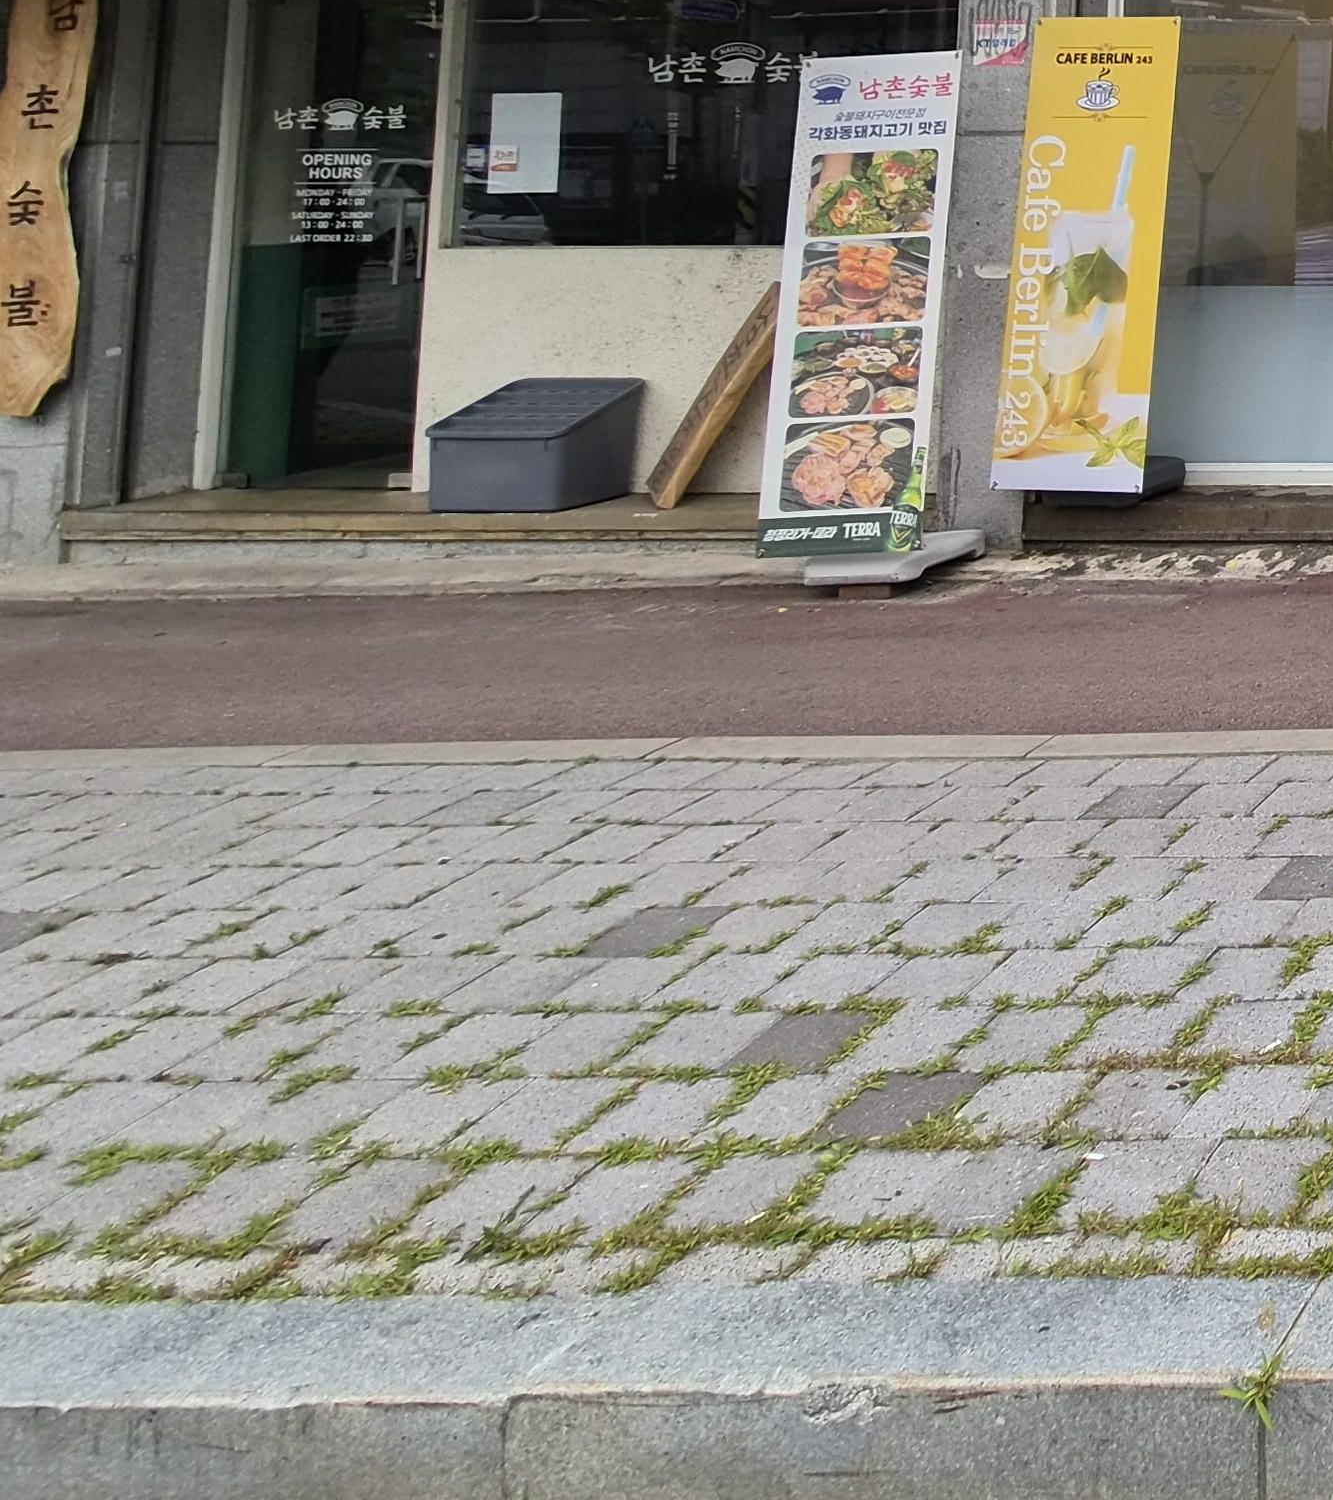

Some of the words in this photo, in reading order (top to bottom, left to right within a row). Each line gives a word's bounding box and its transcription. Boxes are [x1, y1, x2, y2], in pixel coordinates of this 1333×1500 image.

[648, 51, 708, 84] 남촌
[1056, 52, 1088, 65] CAFE
[1090, 52, 1134, 65] BERLIN
[1136, 55, 1154, 65] 243
[858, 72, 954, 101] 남촌숯불
[274, 105, 320, 131] 남촌
[362, 104, 408, 130] 숯불
[834, 107, 928, 123] 숯불돼지구이전문점
[808, 122, 913, 142] 각화동돼지고기
[918, 120, 948, 136] 맛집
[302, 153, 373, 166] OPENING
[308, 166, 363, 179] HOURS
[1022, 134, 1068, 233] Cafe
[1008, 242, 1057, 379] Berlin
[1000, 390, 1032, 448] 243
[842, 521, 881, 539] TERRA
[889, 510, 918, 528] TERRA
